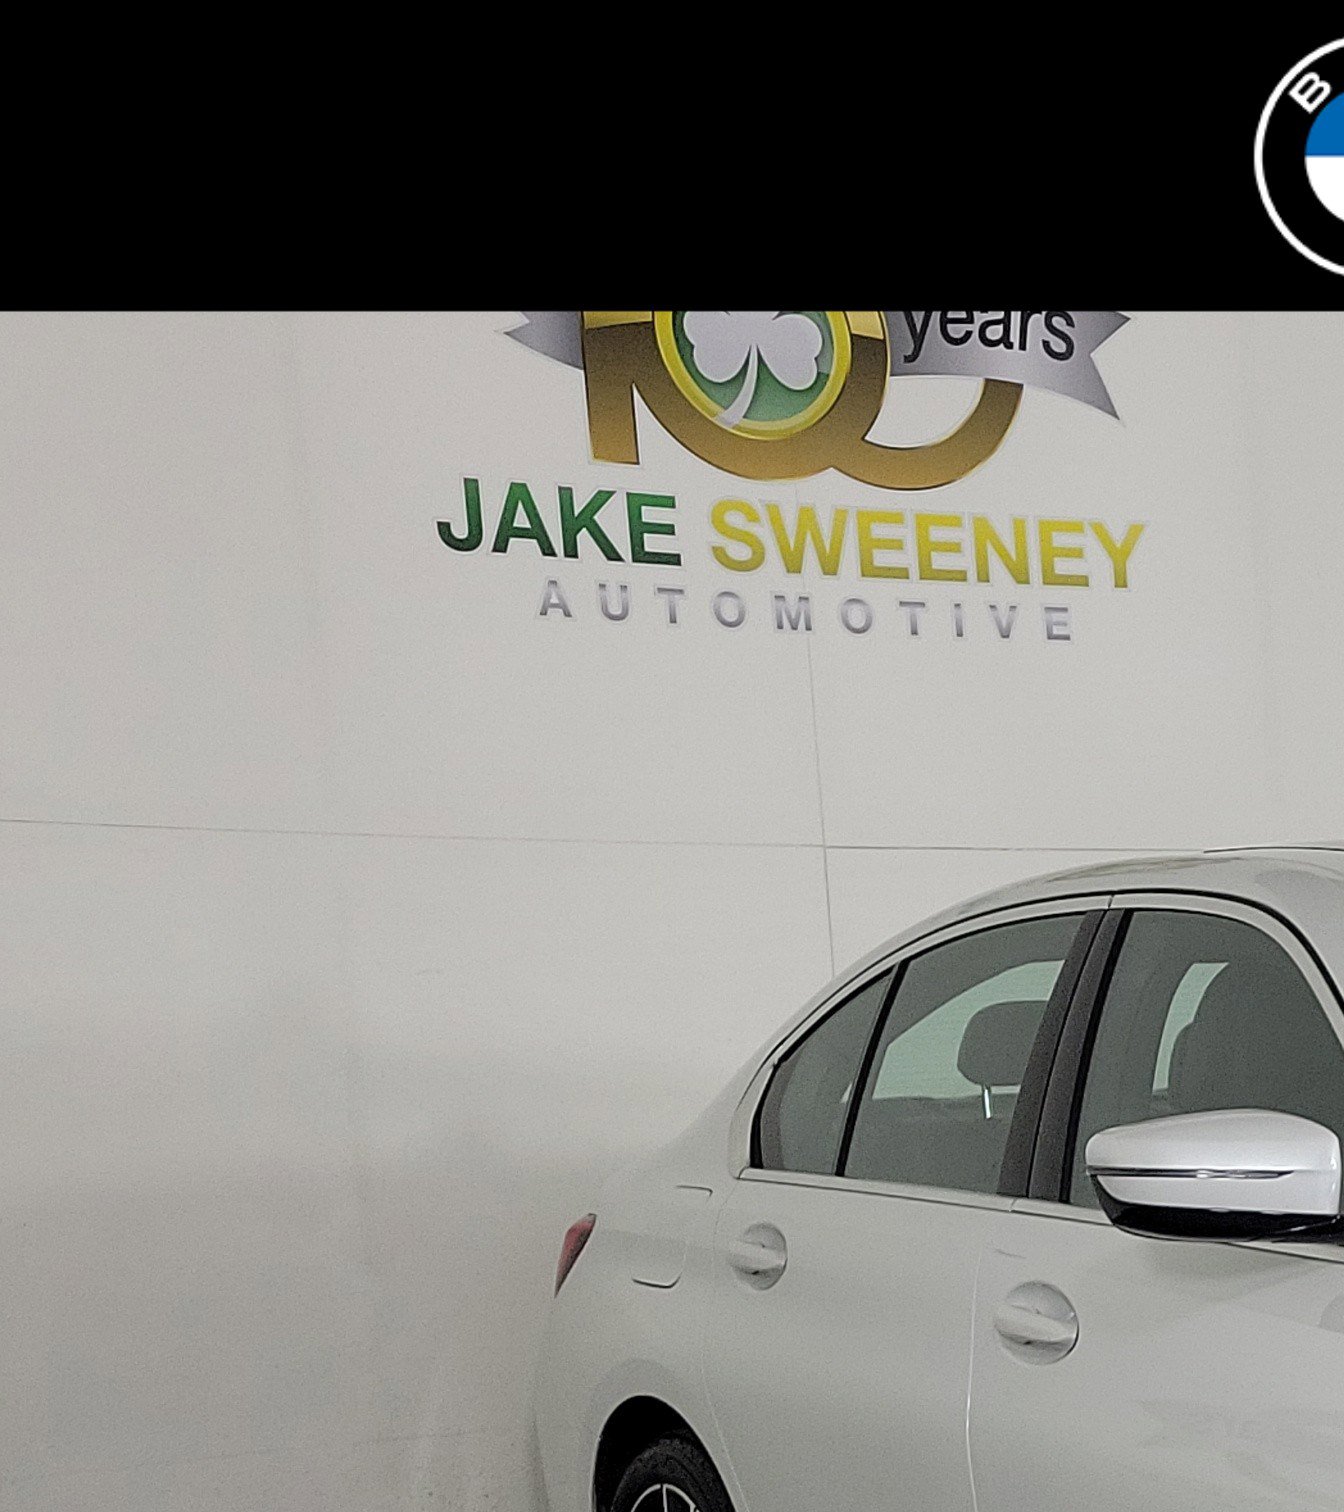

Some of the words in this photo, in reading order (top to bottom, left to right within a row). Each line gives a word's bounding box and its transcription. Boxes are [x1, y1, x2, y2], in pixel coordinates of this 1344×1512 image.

[903, 311, 1075, 362] years
[436, 477, 682, 567] JAKE
[710, 499, 1145, 589] SWEENEY
[538, 580, 1072, 642] AUTOMOTIVE
